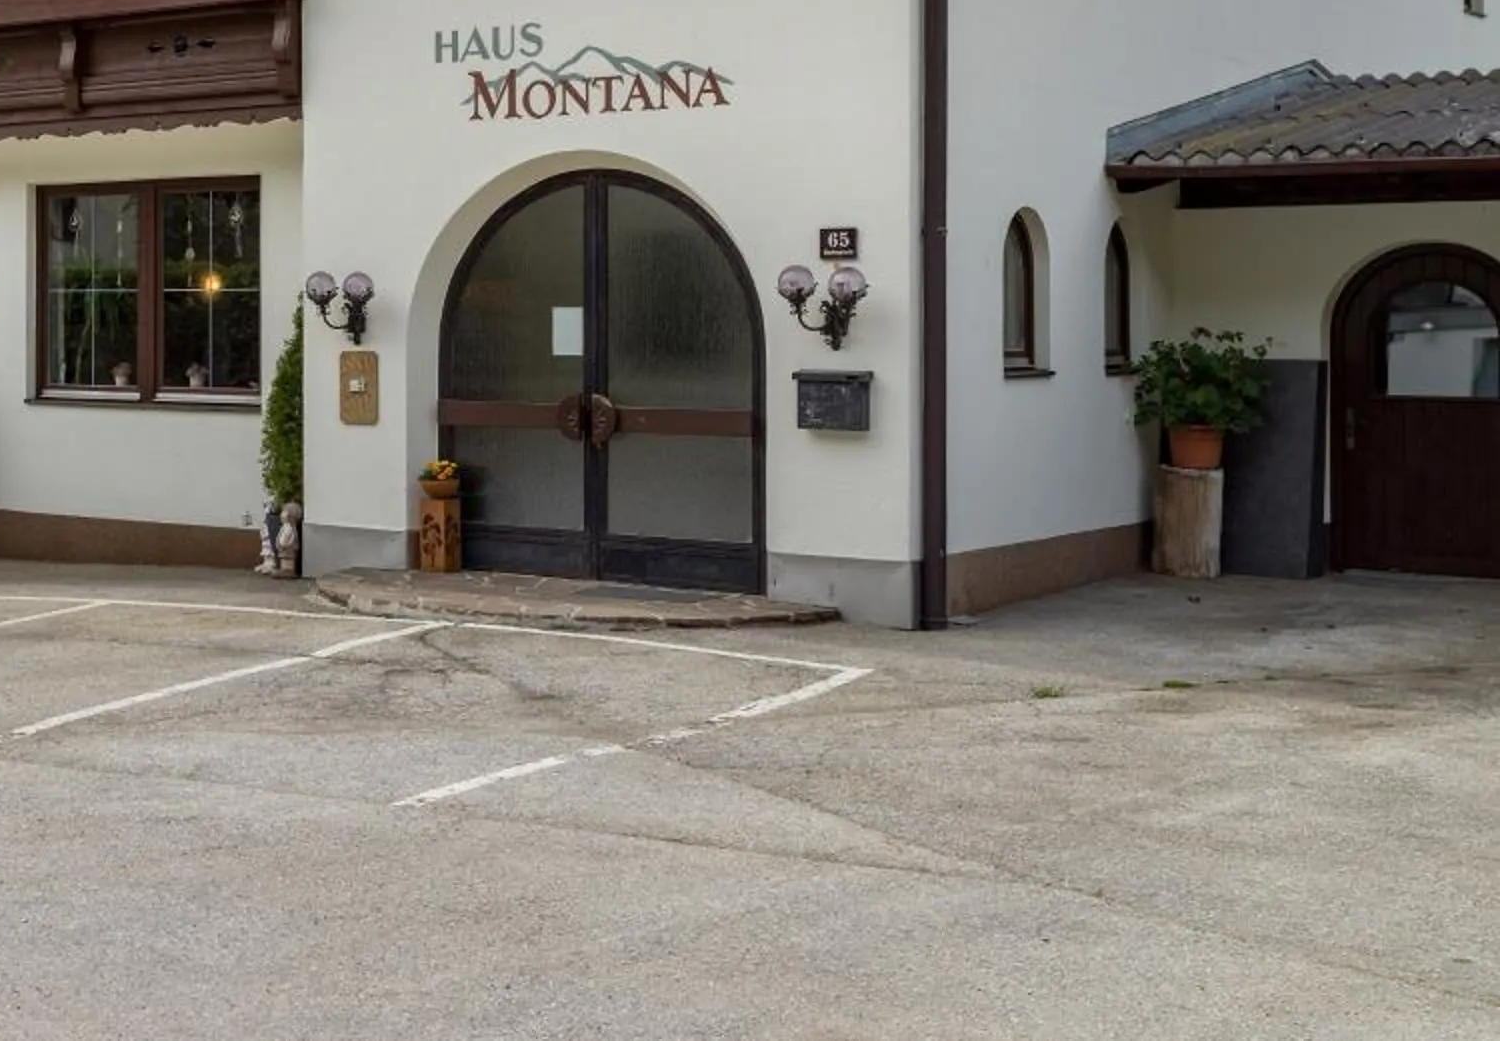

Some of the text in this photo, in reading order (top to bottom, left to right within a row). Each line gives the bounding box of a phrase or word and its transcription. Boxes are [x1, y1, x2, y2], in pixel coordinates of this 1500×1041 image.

[434, 23, 544, 63] HAUS
[468, 67, 730, 121] MONTANA
[828, 232, 850, 247] 65
